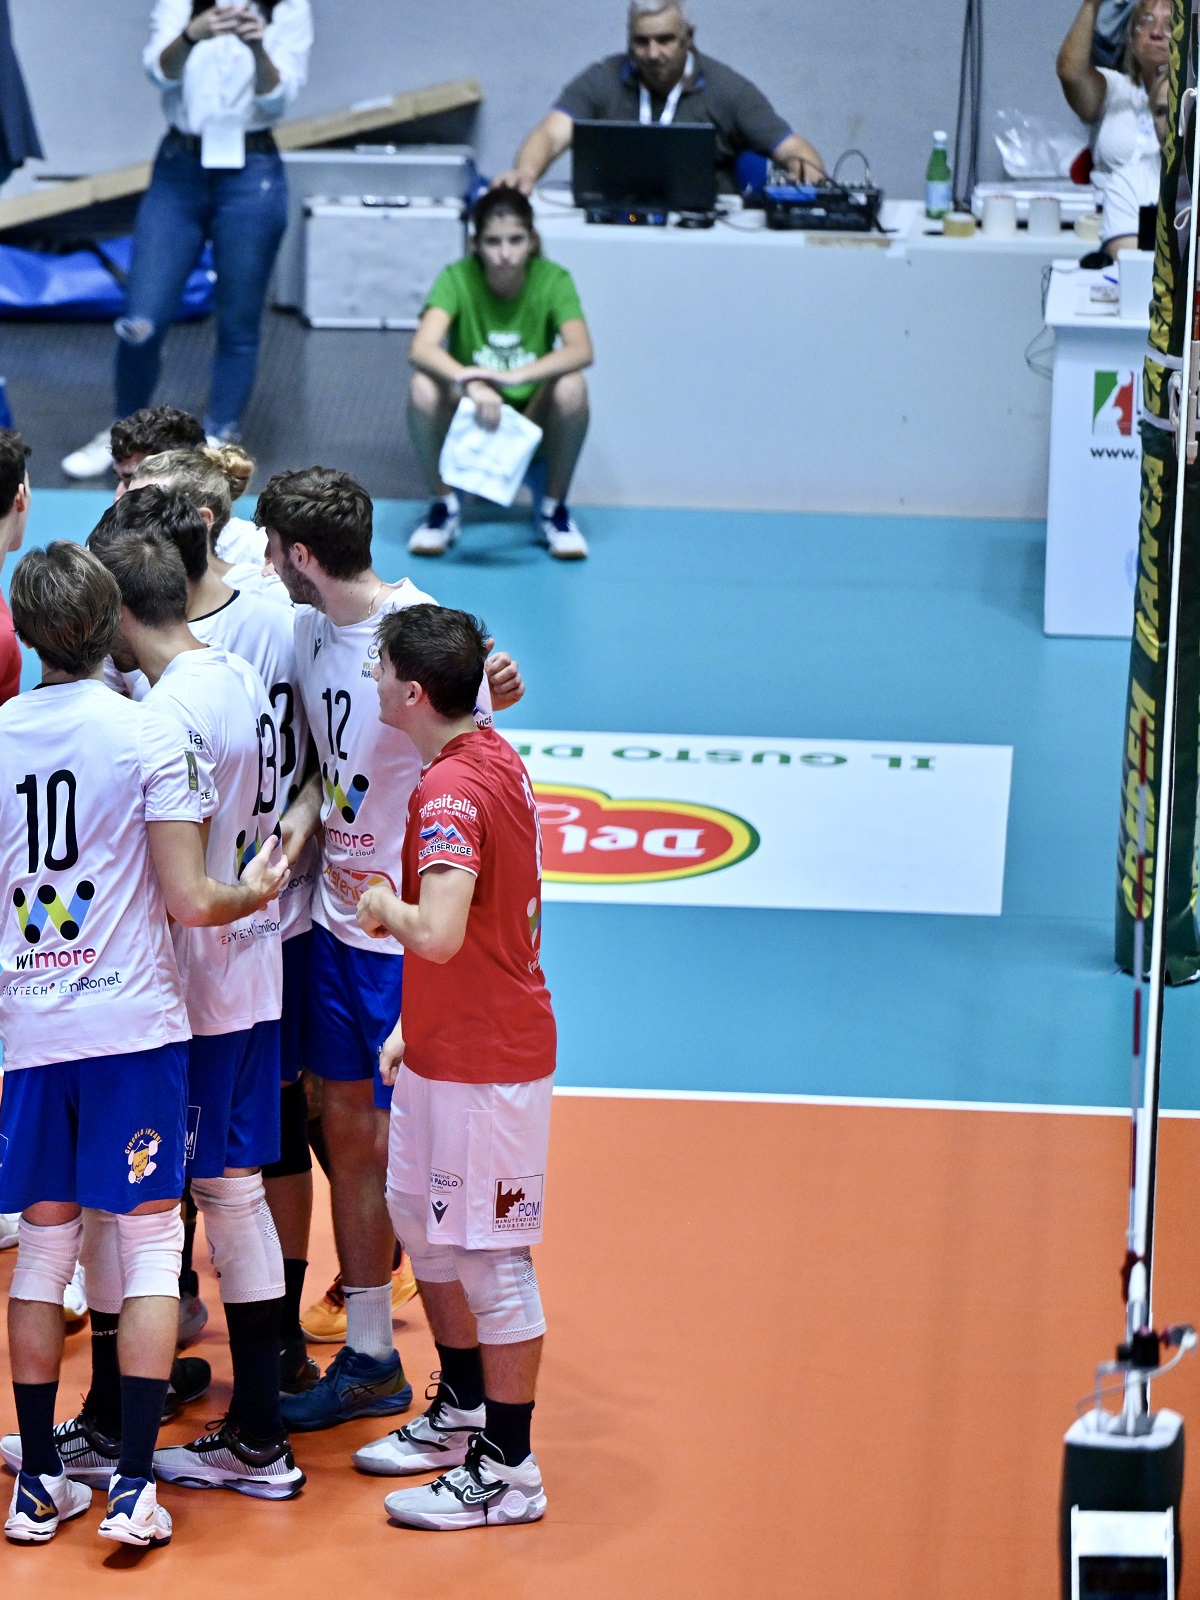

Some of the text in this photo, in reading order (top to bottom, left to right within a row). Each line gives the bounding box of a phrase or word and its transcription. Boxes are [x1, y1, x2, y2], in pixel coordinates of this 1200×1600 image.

[322, 687, 351, 762] 12
[252, 713, 277, 816] 13
[611, 746, 849, 769] GUSTO
[871, 753, 937, 771] IL
[15, 769, 77, 874] 10
[16, 948, 97, 970] wimore
[434, 1178, 458, 1188] PAOLO
[517, 1201, 540, 1217] PCM
[494, 1222, 539, 1230] INDUSTRIALI
[495, 1216, 539, 1225] MANUTENZIONI
